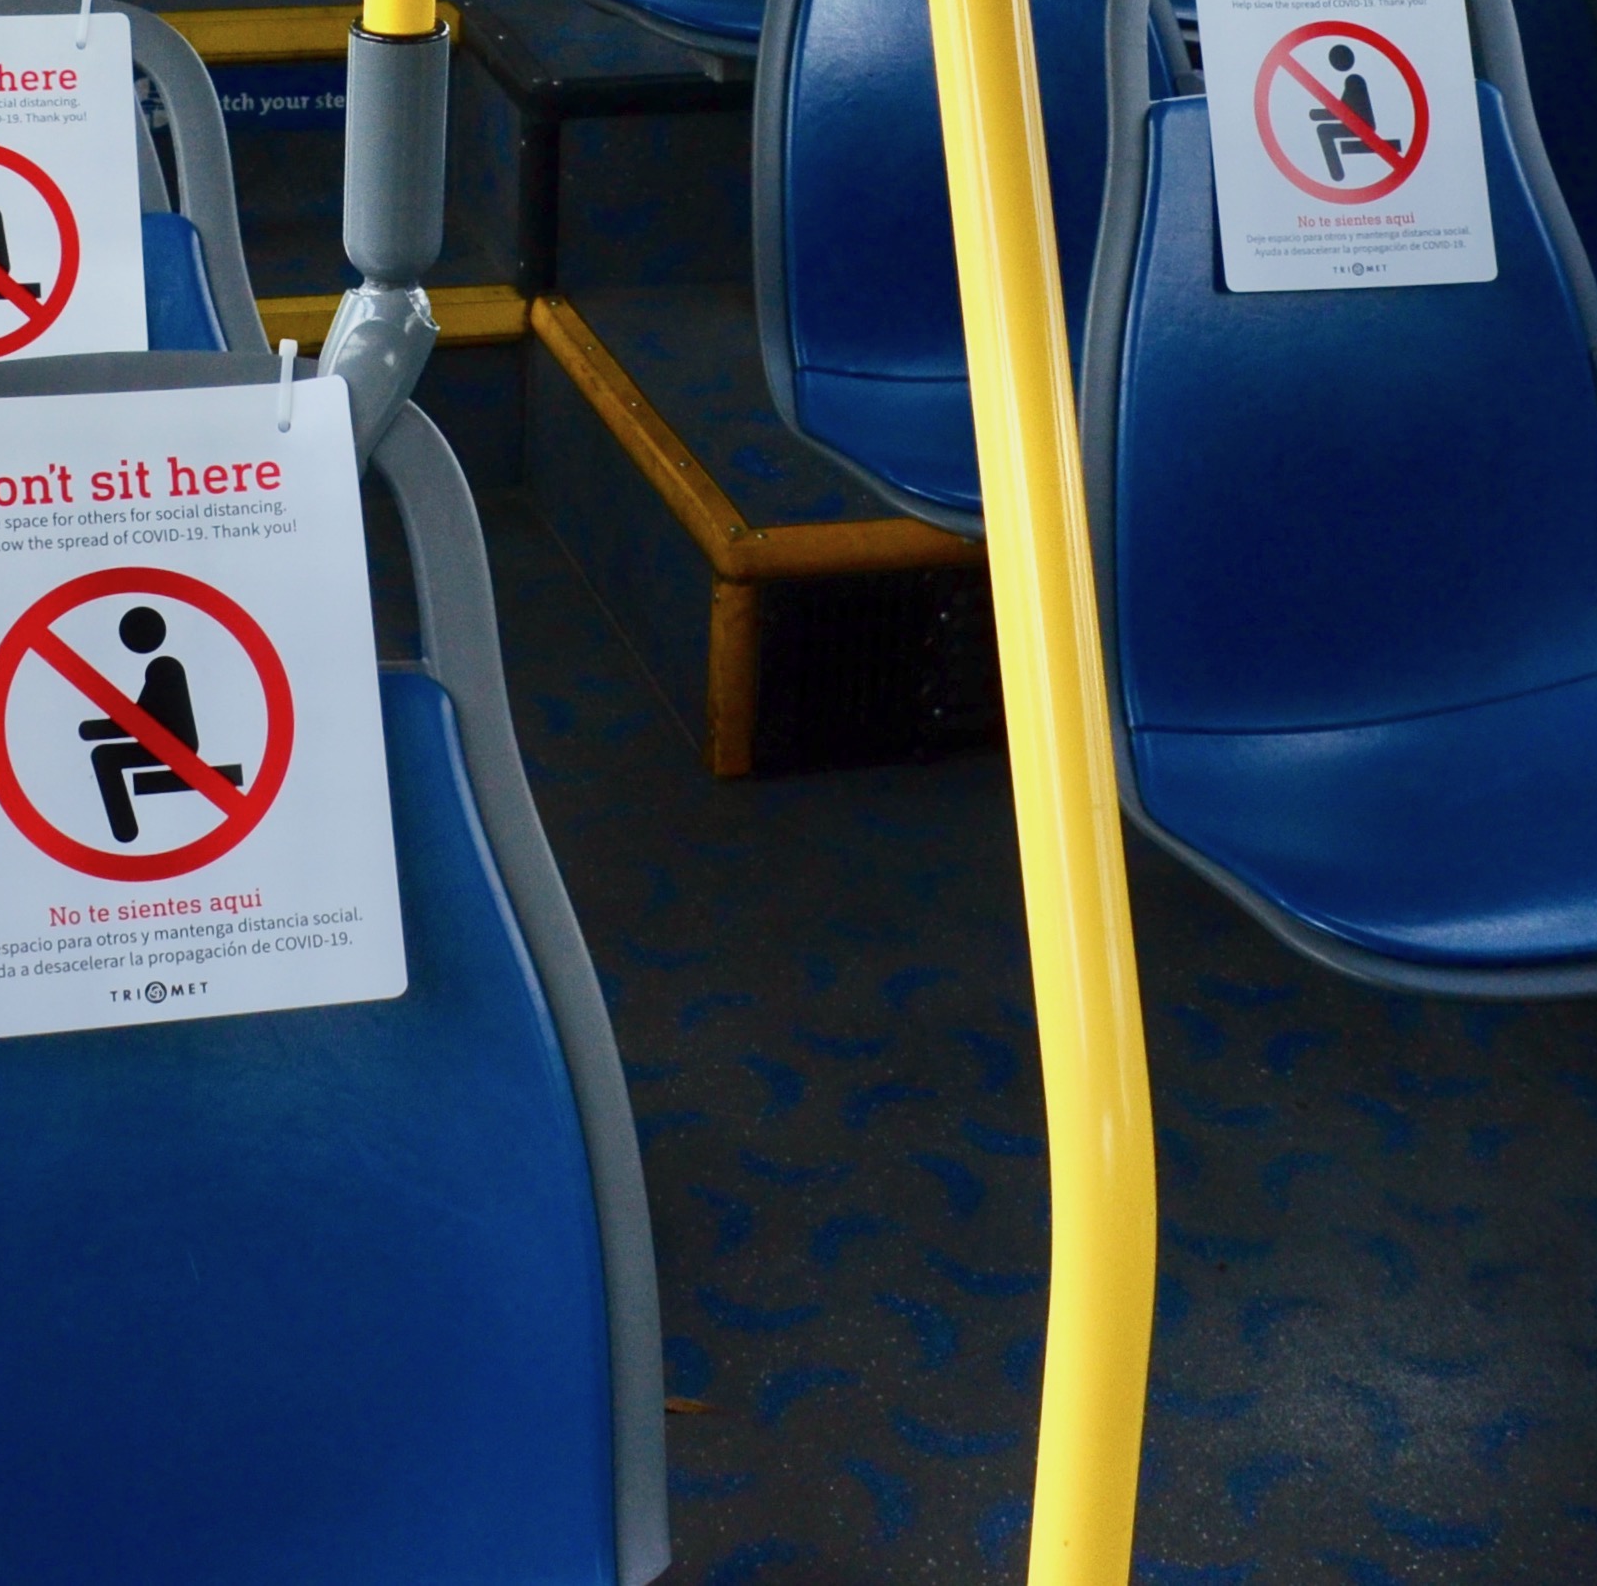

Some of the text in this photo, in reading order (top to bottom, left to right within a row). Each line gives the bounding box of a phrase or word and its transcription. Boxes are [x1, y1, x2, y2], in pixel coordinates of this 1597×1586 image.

[19, 96, 81, 109] distancing.
[25, 112, 61, 123] Thank
[62, 110, 88, 125] you!
[219, 92, 346, 116] tch your ste
[1297, 215, 1316, 228] No
[1319, 215, 1332, 227] te
[1335, 214, 1383, 227] sientes
[90, 458, 152, 503] sit
[166, 456, 282, 498] here
[4, 516, 49, 533] space
[52, 511, 75, 527] for
[77, 510, 127, 526] others
[130, 507, 152, 523] for
[155, 504, 200, 522] social
[203, 499, 288, 518] distancing.
[27, 535, 54, 551] the
[56, 531, 110, 552] spread
[113, 530, 129, 546] of
[131, 526, 209, 545] COVID-19.
[211, 522, 261, 539] Thank
[263, 518, 297, 539] you!
[49, 905, 82, 928] No
[88, 905, 111, 924] te
[117, 898, 203, 921] sientes
[57, 936, 93, 954] para
[96, 932, 138, 947] otros
[140, 931, 150, 946] y
[154, 923, 234, 941] mantenga
[237, 912, 310, 934] distancia
[312, 906, 364, 926] social.
[20, 965, 30, 977] a
[33, 955, 126, 976] desacelerar
[129, 951, 144, 967] la
[148, 940, 248, 969] propagación
[251, 939, 272, 955] de
[274, 930, 353, 952] COVID-19.
